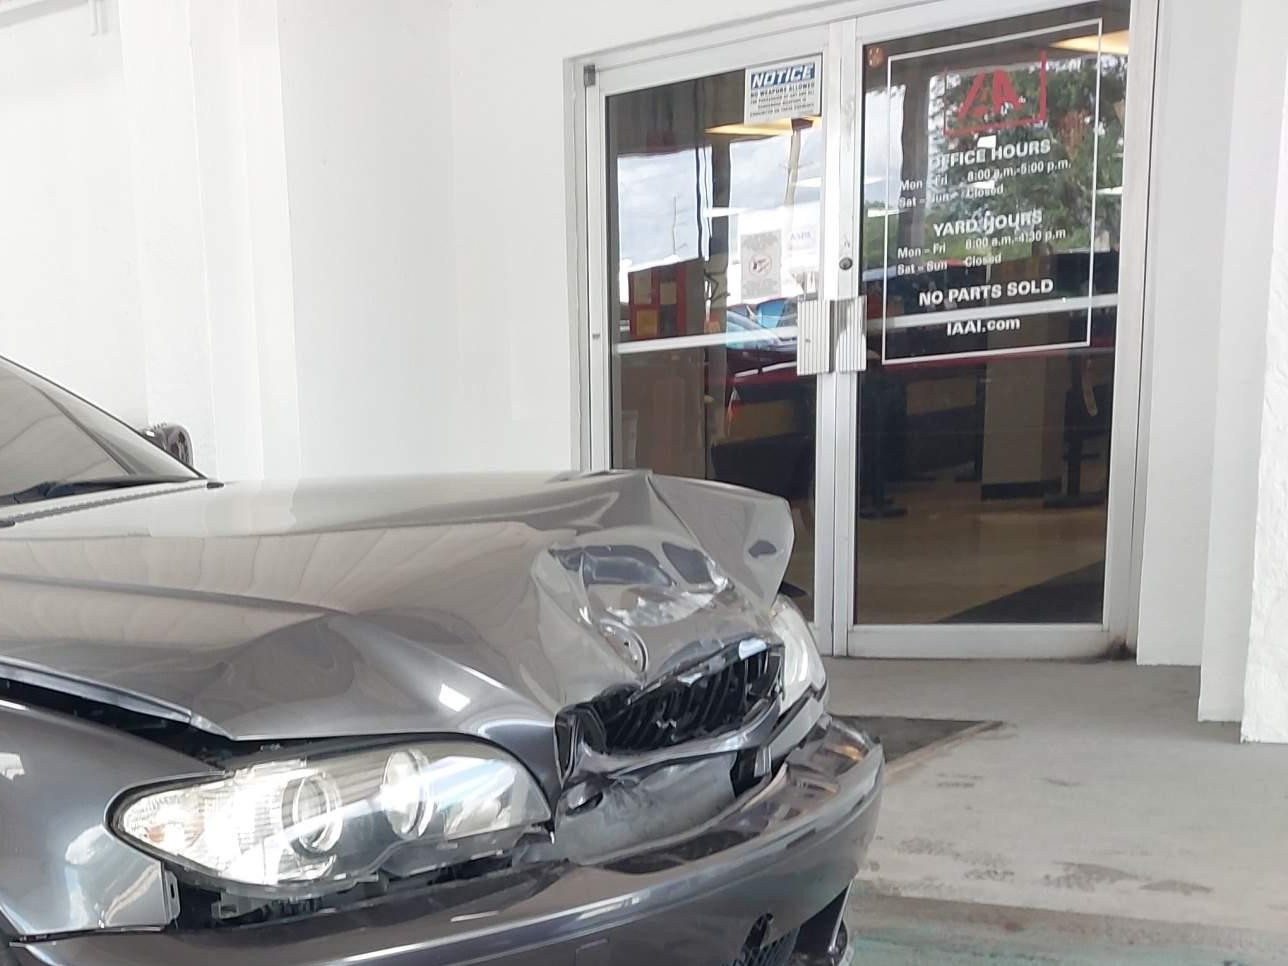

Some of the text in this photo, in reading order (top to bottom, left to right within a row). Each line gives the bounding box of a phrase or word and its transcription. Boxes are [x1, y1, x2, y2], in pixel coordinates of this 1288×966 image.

[752, 64, 815, 89] NOTICE
[992, 138, 1051, 161] HOURS
[901, 179, 923, 191] Mon
[933, 208, 1042, 237] YARD HOURS
[897, 246, 922, 259] Mon
[933, 242, 946, 255] Fri
[965, 236, 989, 250] 8:00
[897, 263, 916, 276] Sat
[926, 260, 947, 273] Sun
[964, 252, 1002, 268] Closed
[919, 279, 1053, 306] NO PARTS SOLD
